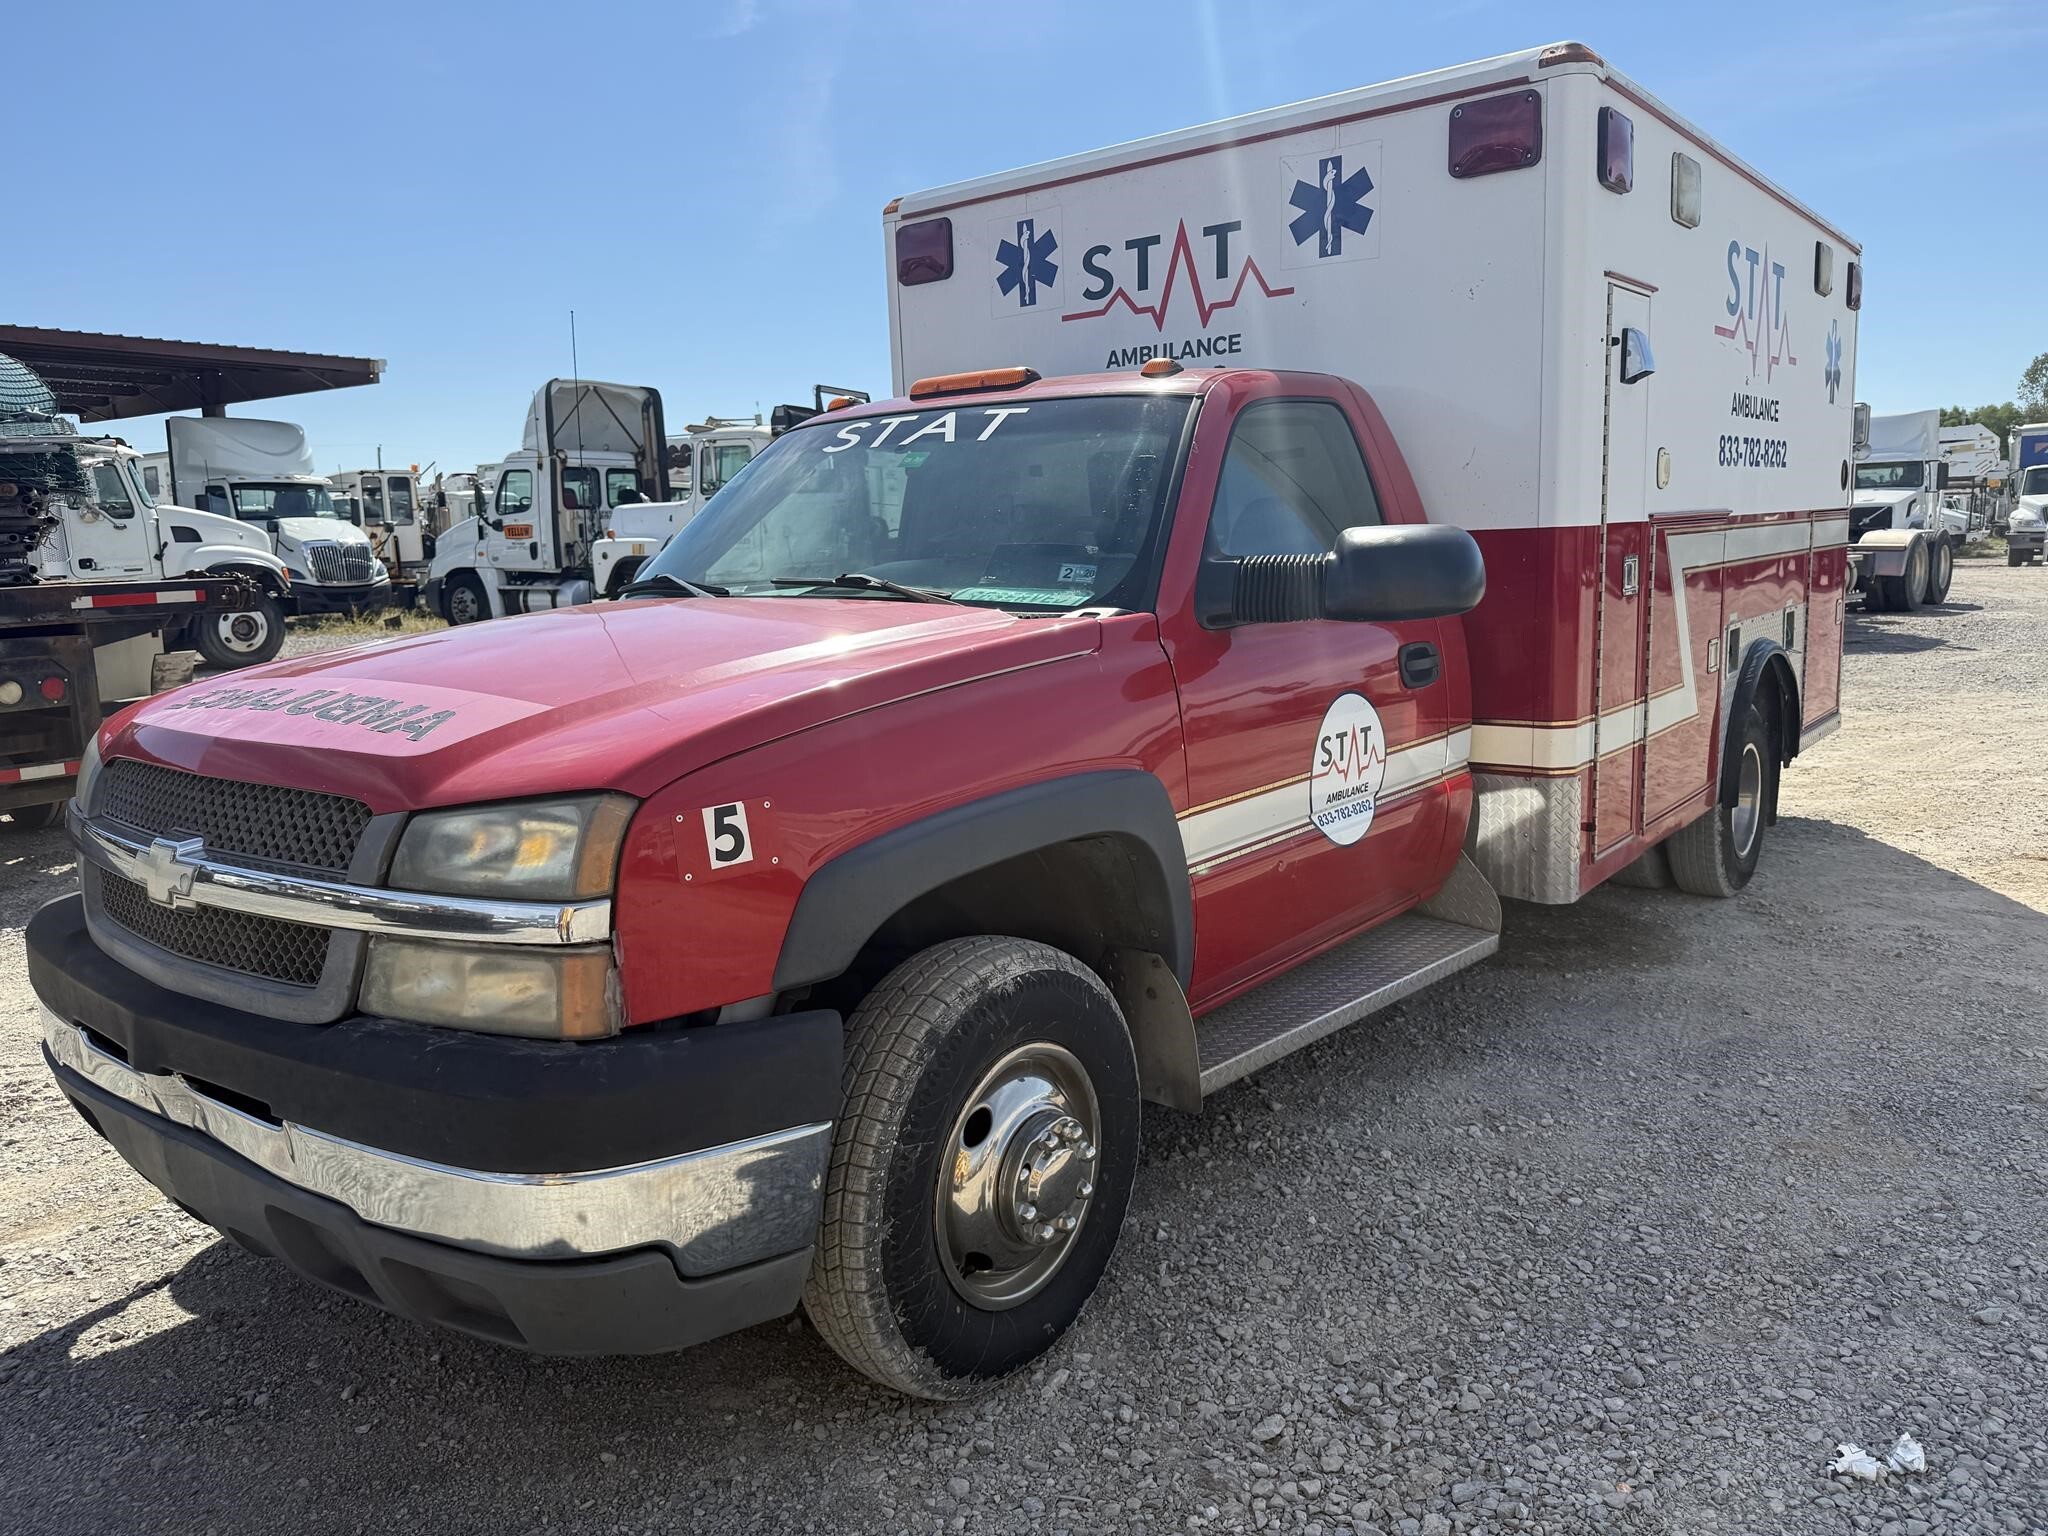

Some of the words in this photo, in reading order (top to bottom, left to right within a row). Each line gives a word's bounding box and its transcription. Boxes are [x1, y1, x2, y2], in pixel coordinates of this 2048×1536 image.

[1082, 217, 1242, 308] STAT
[1726, 239, 1785, 334] STAT
[1106, 333, 1242, 368] AMBULANCE
[1731, 392, 1780, 422] AMBULANCE
[822, 408, 1031, 453] STAT
[1719, 434, 1787, 468] 833-782-8262
[506, 527, 530, 537] YELLOW
[1063, 567, 1074, 578] 2
[1320, 723, 1372, 772] STAT
[1325, 782, 1369, 805] AMBULANCE
[1317, 799, 1373, 827] 833-782-8262
[714, 803, 745, 862] 5
